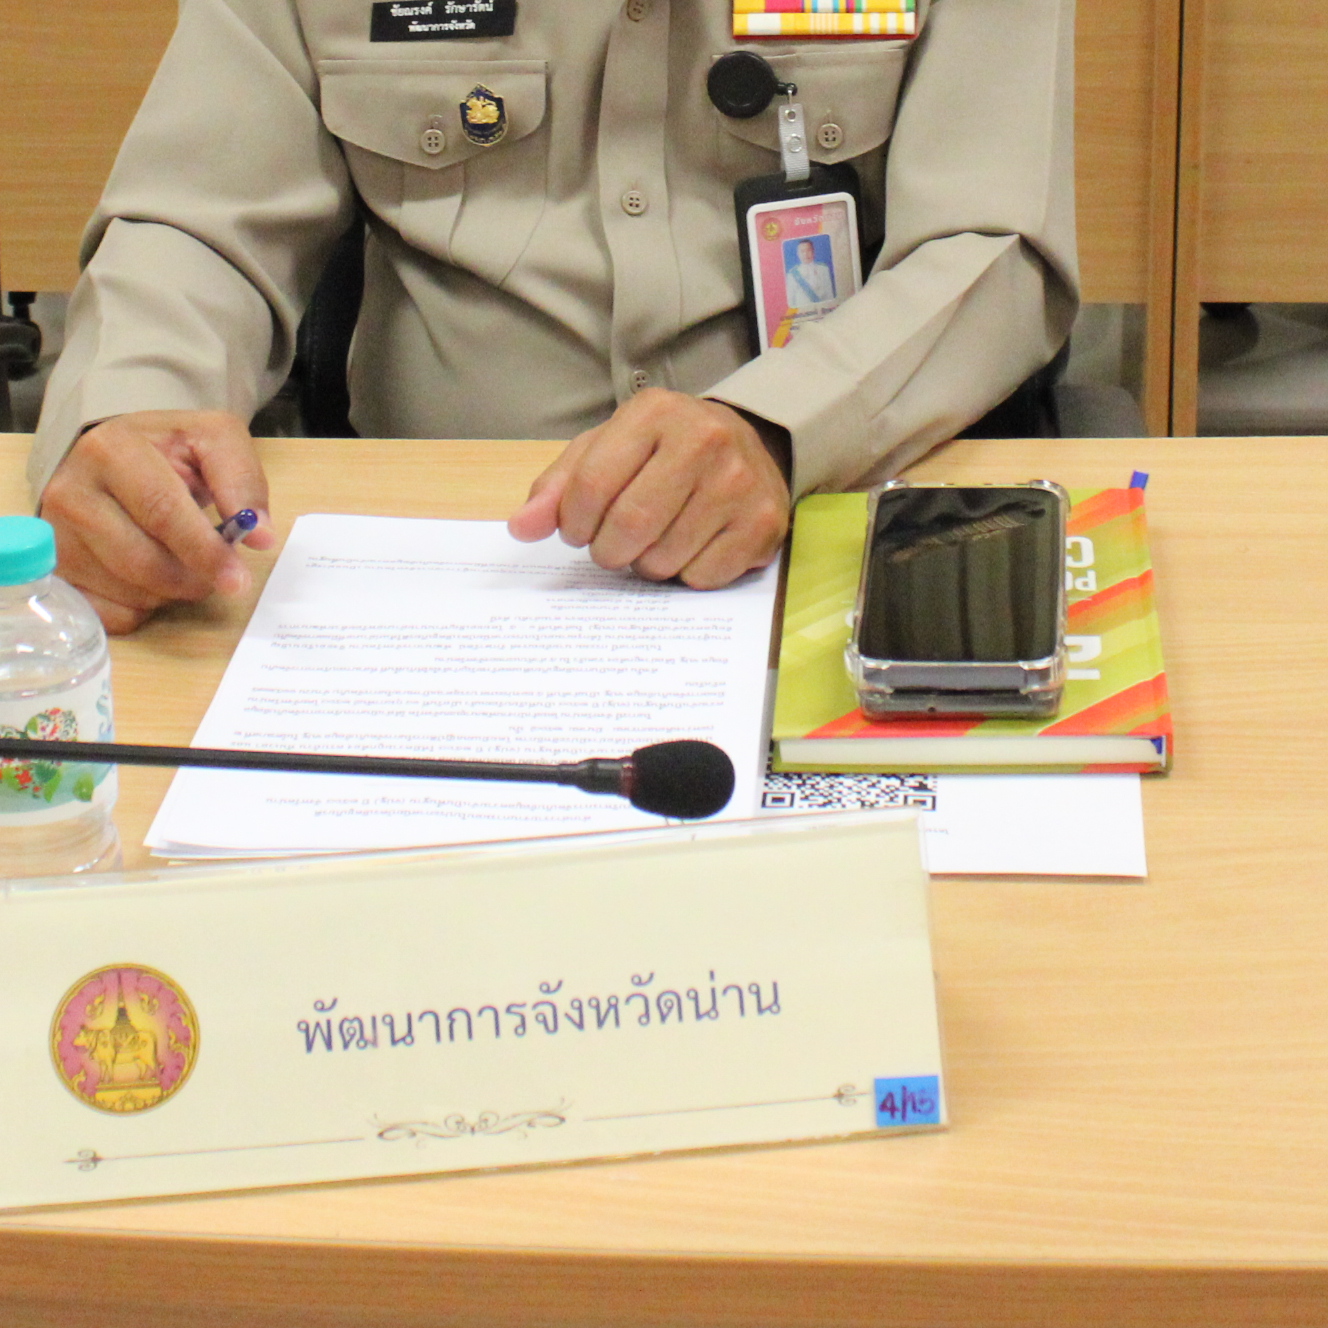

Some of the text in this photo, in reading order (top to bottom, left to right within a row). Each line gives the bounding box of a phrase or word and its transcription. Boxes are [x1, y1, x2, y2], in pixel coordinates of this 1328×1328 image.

[296, 971, 783, 1054] พัฒนาการจังหวัดน่าน
